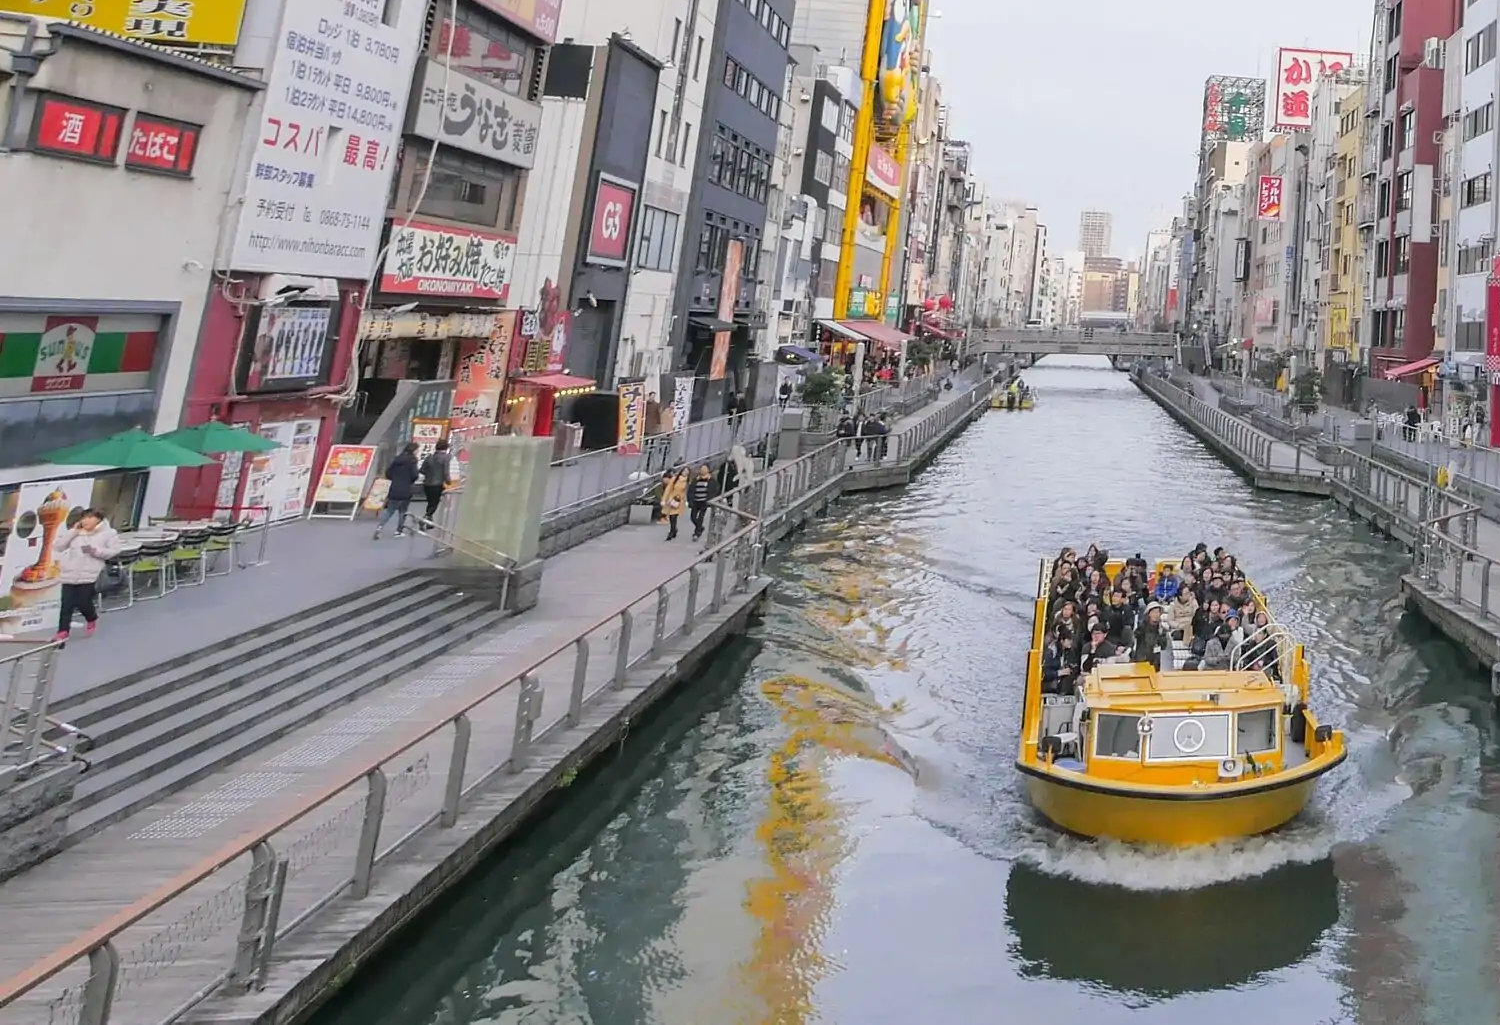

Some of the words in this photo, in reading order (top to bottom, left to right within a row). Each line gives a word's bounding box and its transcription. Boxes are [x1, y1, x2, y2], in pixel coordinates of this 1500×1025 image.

[57, 111, 86, 145] 酒
[128, 126, 180, 162] たばこ
[263, 116, 325, 157] コスパ
[343, 133, 390, 171] 最高!
[1270, 178, 1281, 205] ツルハ
[602, 200, 623, 240] G3
[416, 233, 484, 279] お好み焼
[417, 279, 475, 294] OKONOMIYAKI
